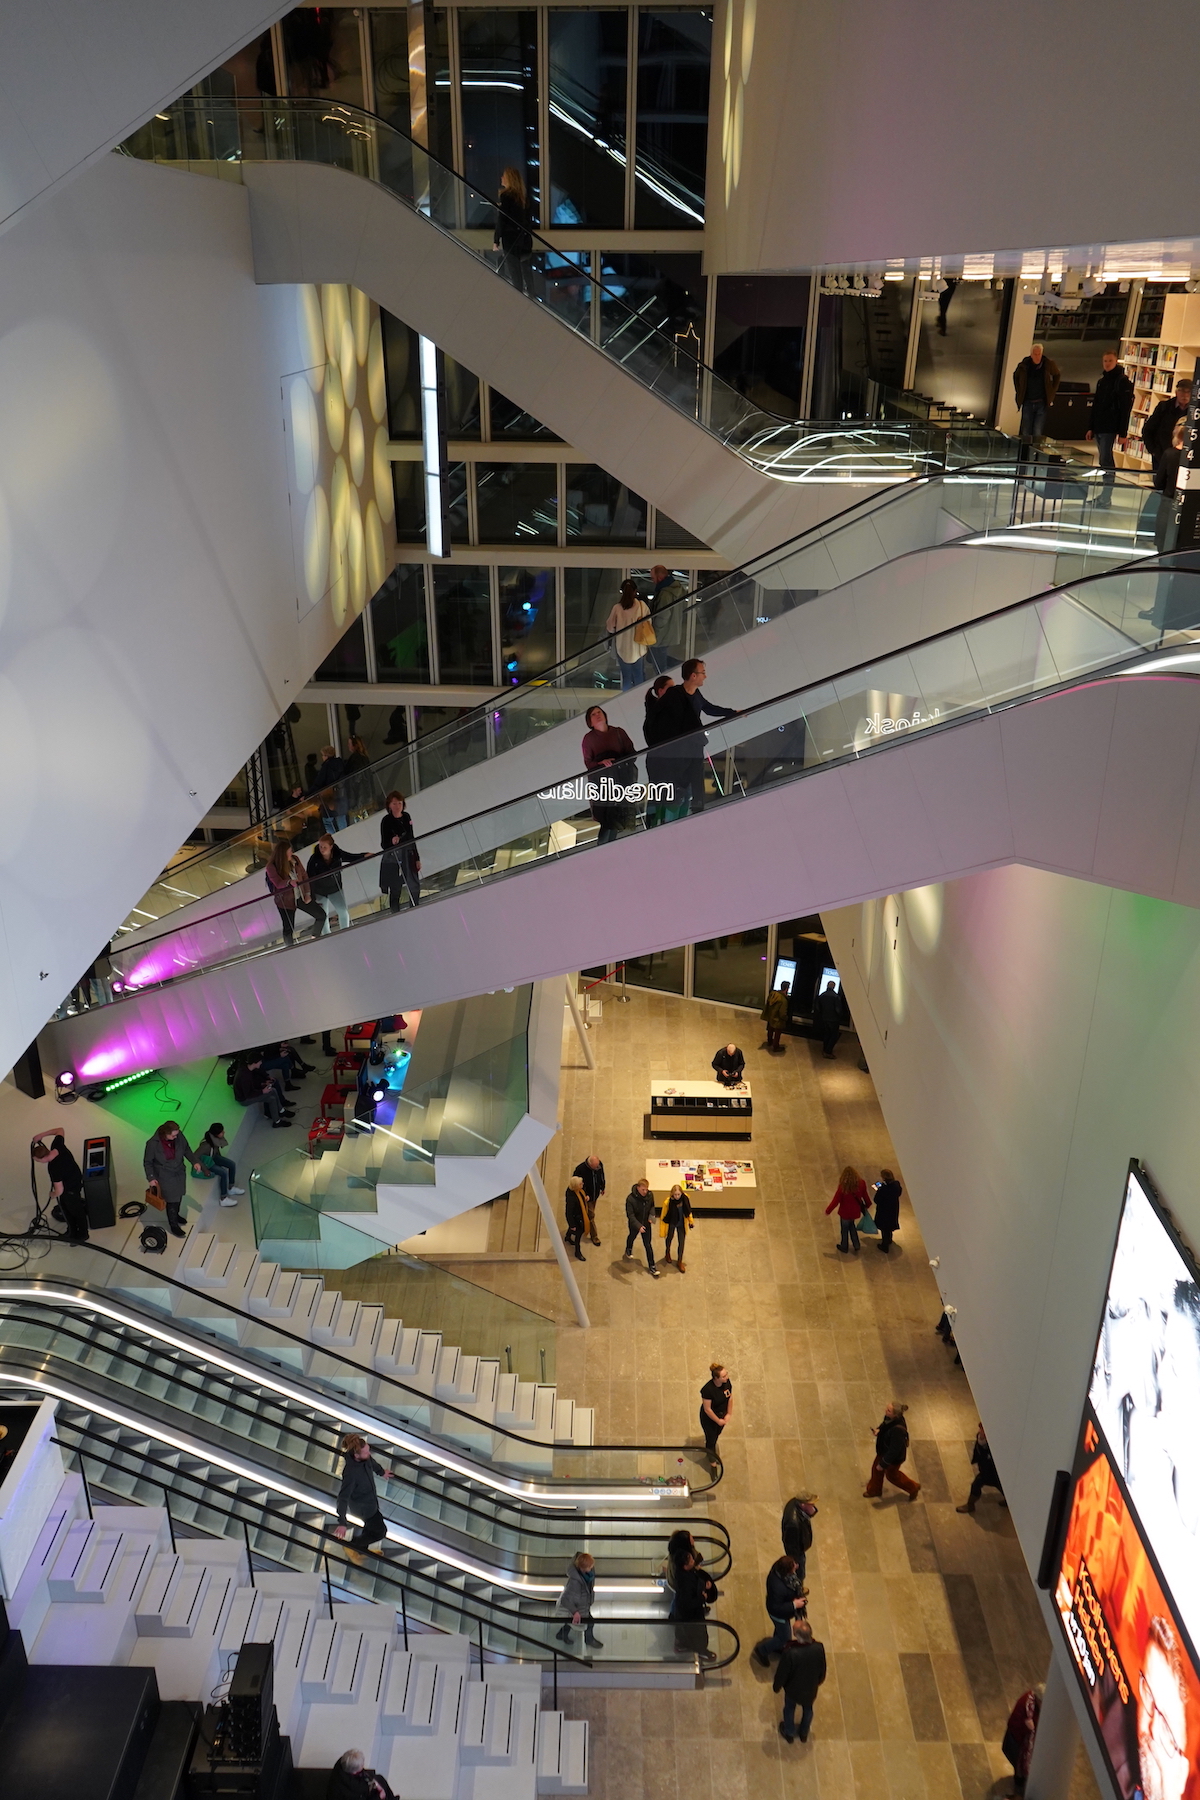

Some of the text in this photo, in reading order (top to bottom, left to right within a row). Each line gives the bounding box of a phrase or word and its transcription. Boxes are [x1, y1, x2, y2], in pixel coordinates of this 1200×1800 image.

[1186, 449, 1194, 461] 4
[1074, 1585, 1105, 1676] Helden
[1078, 1560, 1129, 1705] Koolhovens
